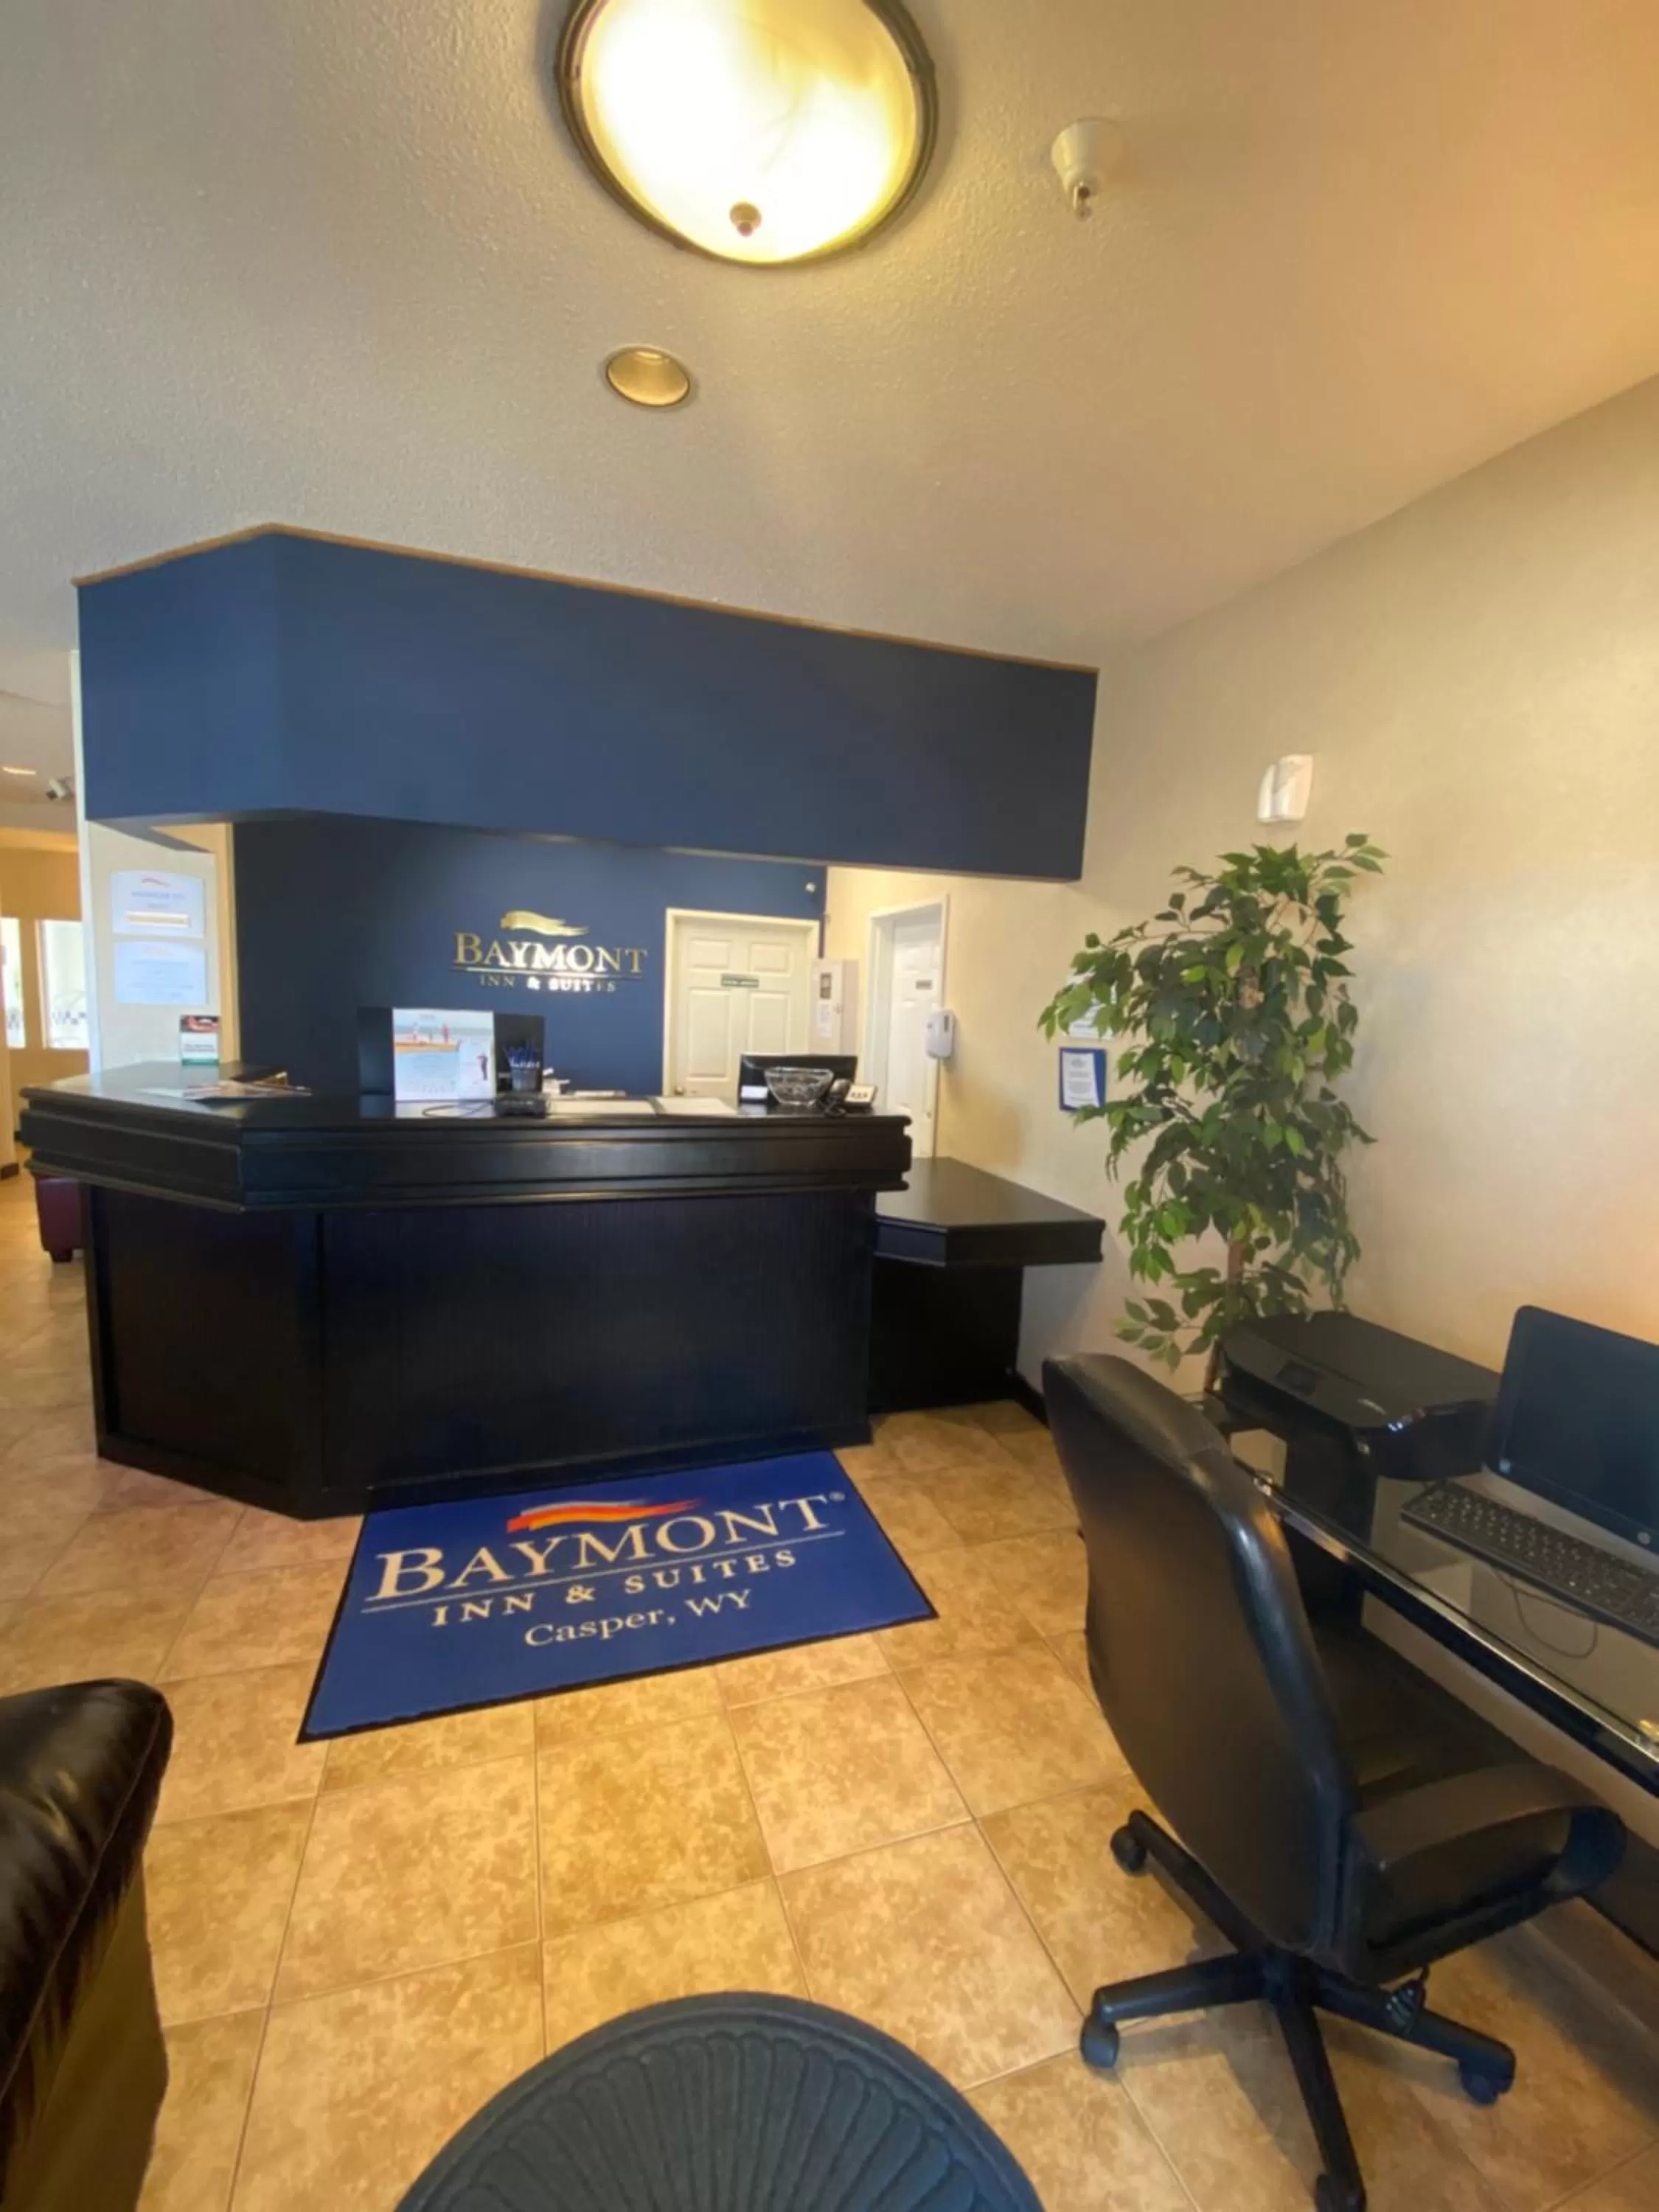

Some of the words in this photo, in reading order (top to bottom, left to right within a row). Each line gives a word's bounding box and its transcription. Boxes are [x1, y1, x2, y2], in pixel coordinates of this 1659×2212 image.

[453, 932, 647, 974] BAYMONT
[480, 974, 515, 988] INN
[432, 1592, 536, 1627] INN
[566, 1585, 596, 1605] &
[624, 1549, 796, 1594] SUITES
[524, 1608, 676, 1646] Casper,
[684, 1589, 751, 1618] WY
